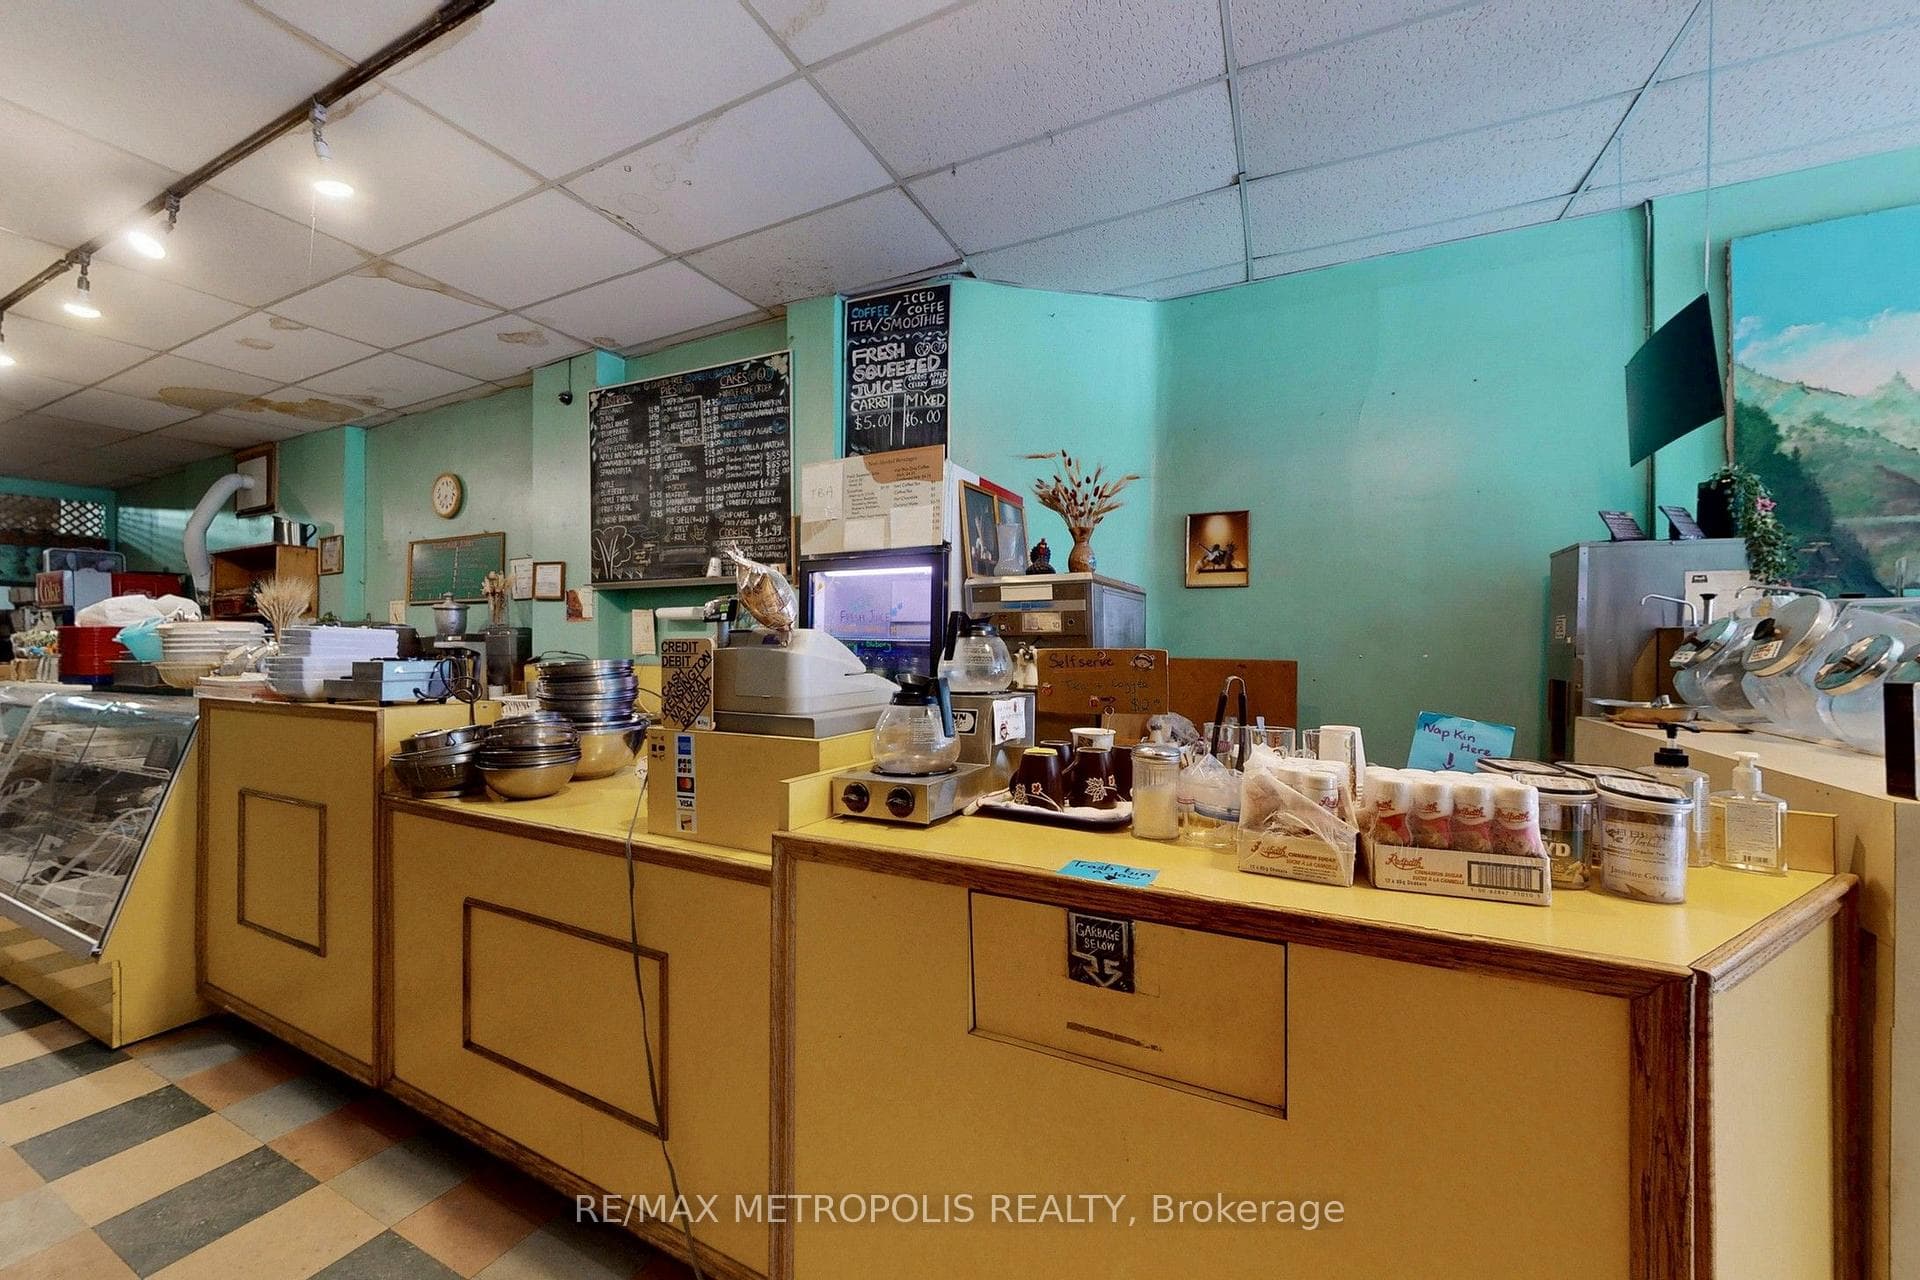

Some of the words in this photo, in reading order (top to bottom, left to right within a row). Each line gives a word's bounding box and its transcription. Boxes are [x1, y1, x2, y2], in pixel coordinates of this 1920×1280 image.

[904, 291, 934, 305] ICED
[907, 301, 944, 315] COFFE
[852, 342, 906, 367] FRESH
[853, 354, 941, 382] SQUEEZED
[720, 372, 748, 386] CAKES
[852, 378, 904, 398] JUICE
[851, 395, 891, 412] CARROT
[906, 394, 946, 407] MIXED
[855, 412, 890, 430] $5.00
[719, 527, 750, 538] COOKIES
[755, 525, 782, 538] $1.99
[661, 641, 698, 653] CREDIT
[662, 656, 692, 667] DEBIT
[662, 668, 685, 698] CASH
[662, 650, 712, 716] KENSINGTON
[670, 676, 712, 722] NATURAL
[681, 684, 712, 728] BAKERY
[1460, 742, 1491, 756] Here
[1075, 860, 1114, 872] Trash
[1384, 852, 1424, 870] Redpath
[1076, 922, 1120, 941] GARBAGE
